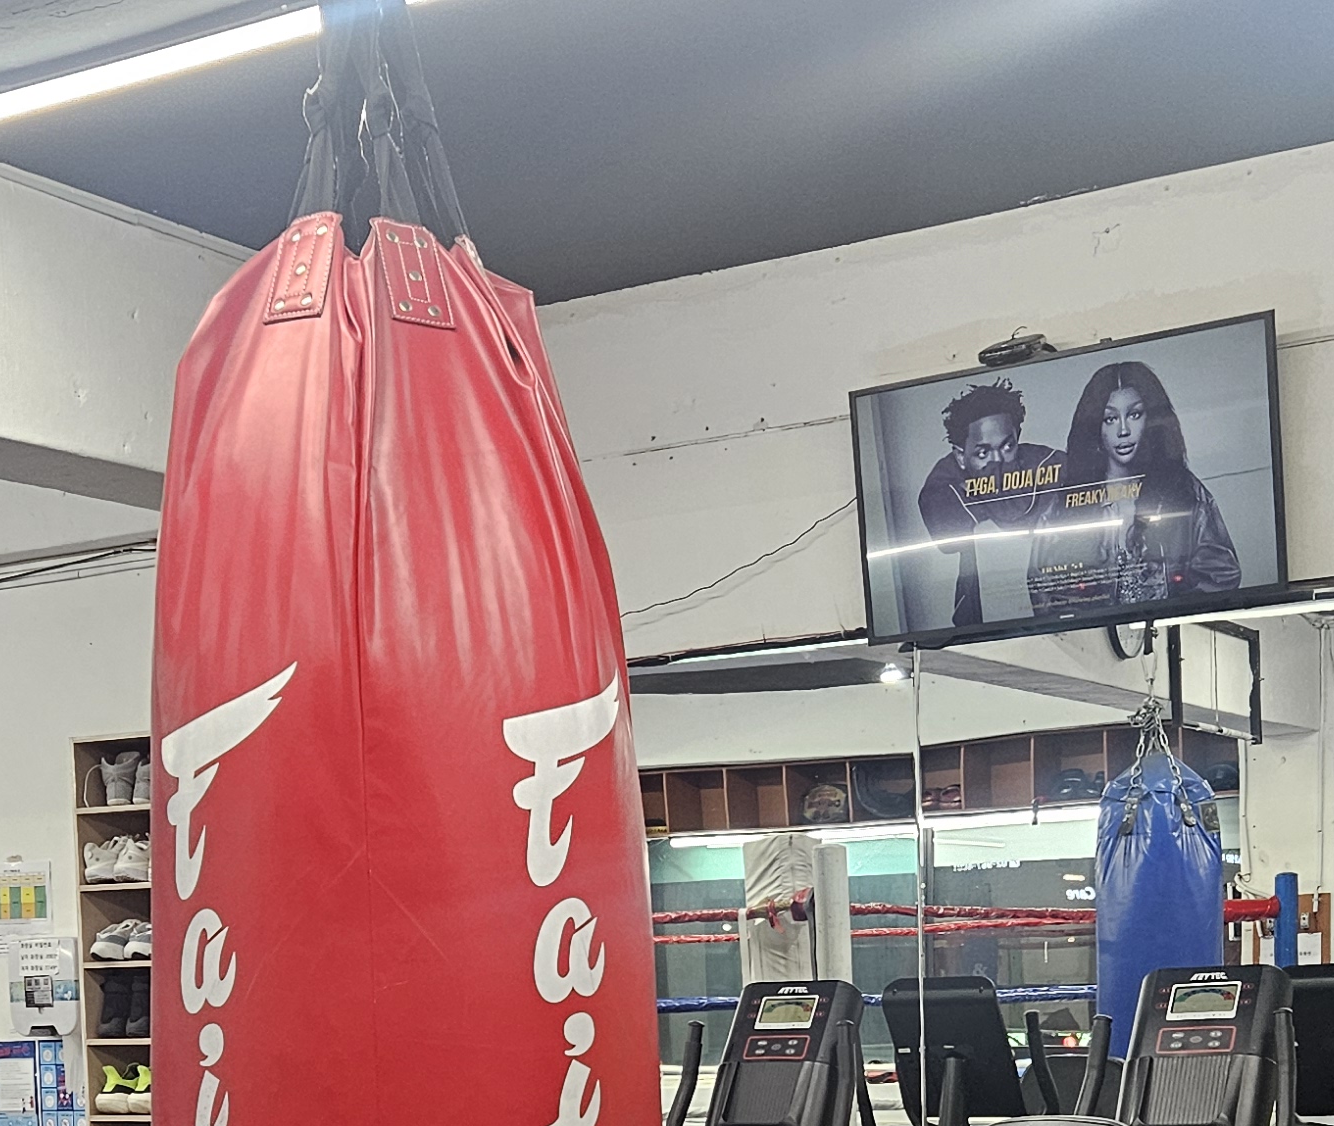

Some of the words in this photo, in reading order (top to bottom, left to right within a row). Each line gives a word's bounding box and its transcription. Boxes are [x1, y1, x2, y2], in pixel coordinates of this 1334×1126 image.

[965, 475, 999, 497] TYGA,
[1003, 469, 1033, 490] DOJA
[1037, 464, 1061, 485] CAT
[1066, 488, 1105, 508] FREAKY
